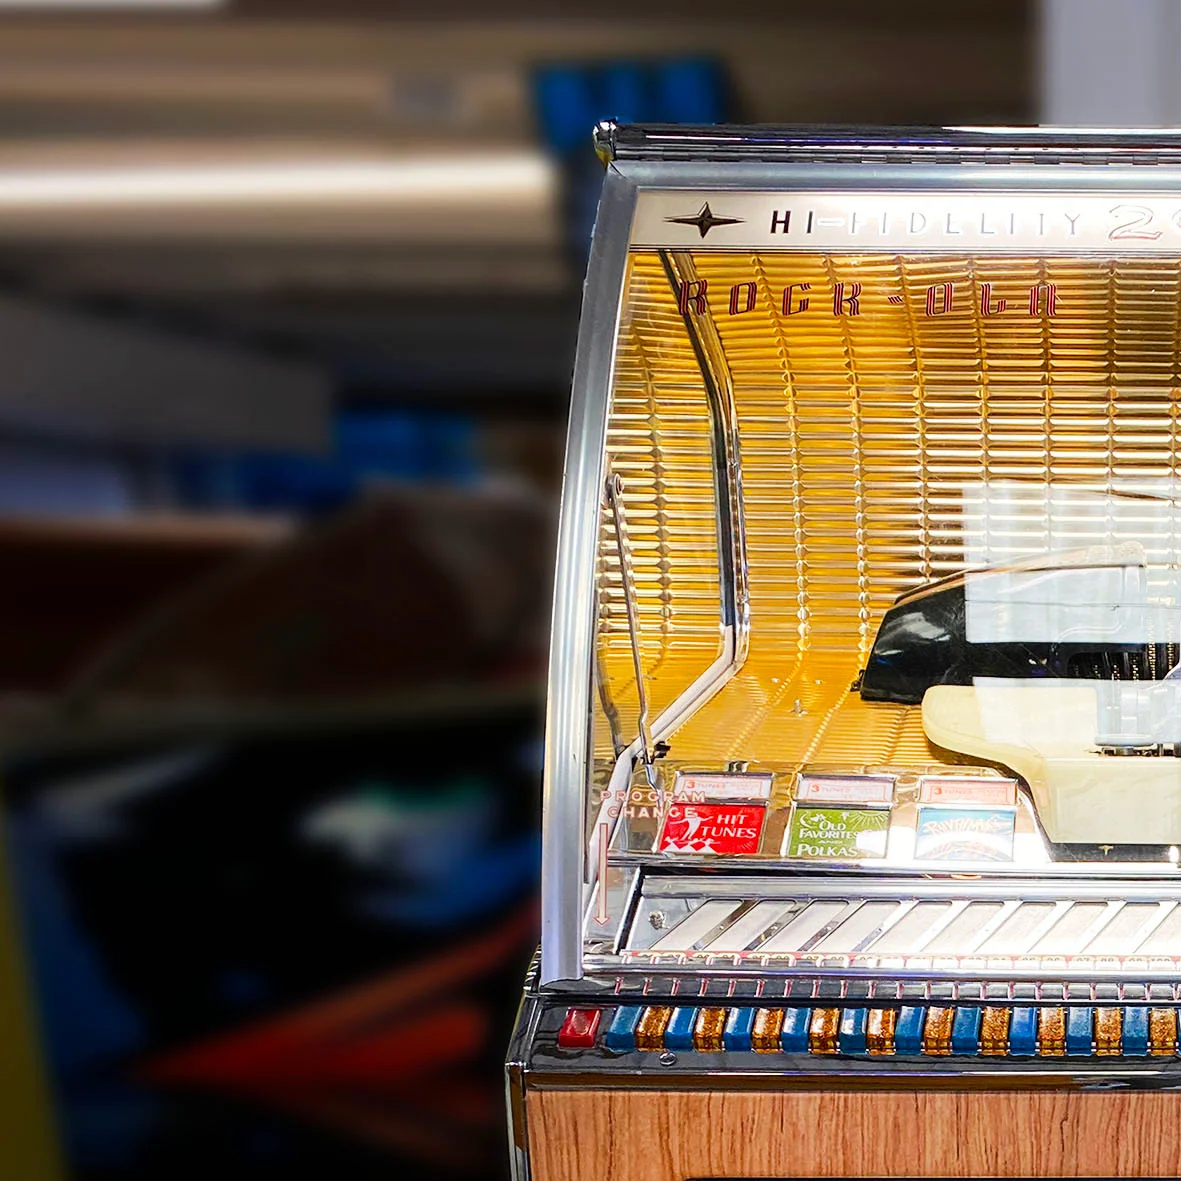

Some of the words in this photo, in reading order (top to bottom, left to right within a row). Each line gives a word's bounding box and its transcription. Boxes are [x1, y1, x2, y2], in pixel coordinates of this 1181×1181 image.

[770, 210, 1081, 236] HI-FIDELITY
[600, 789, 706, 803] PROGRAM
[607, 806, 699, 819] CHANGE
[716, 814, 748, 825] HIT
[819, 820, 846, 831] OLD
[700, 826, 757, 839] TUNES
[799, 828, 859, 839] FAVORITES
[797, 843, 858, 857] POLKAS
